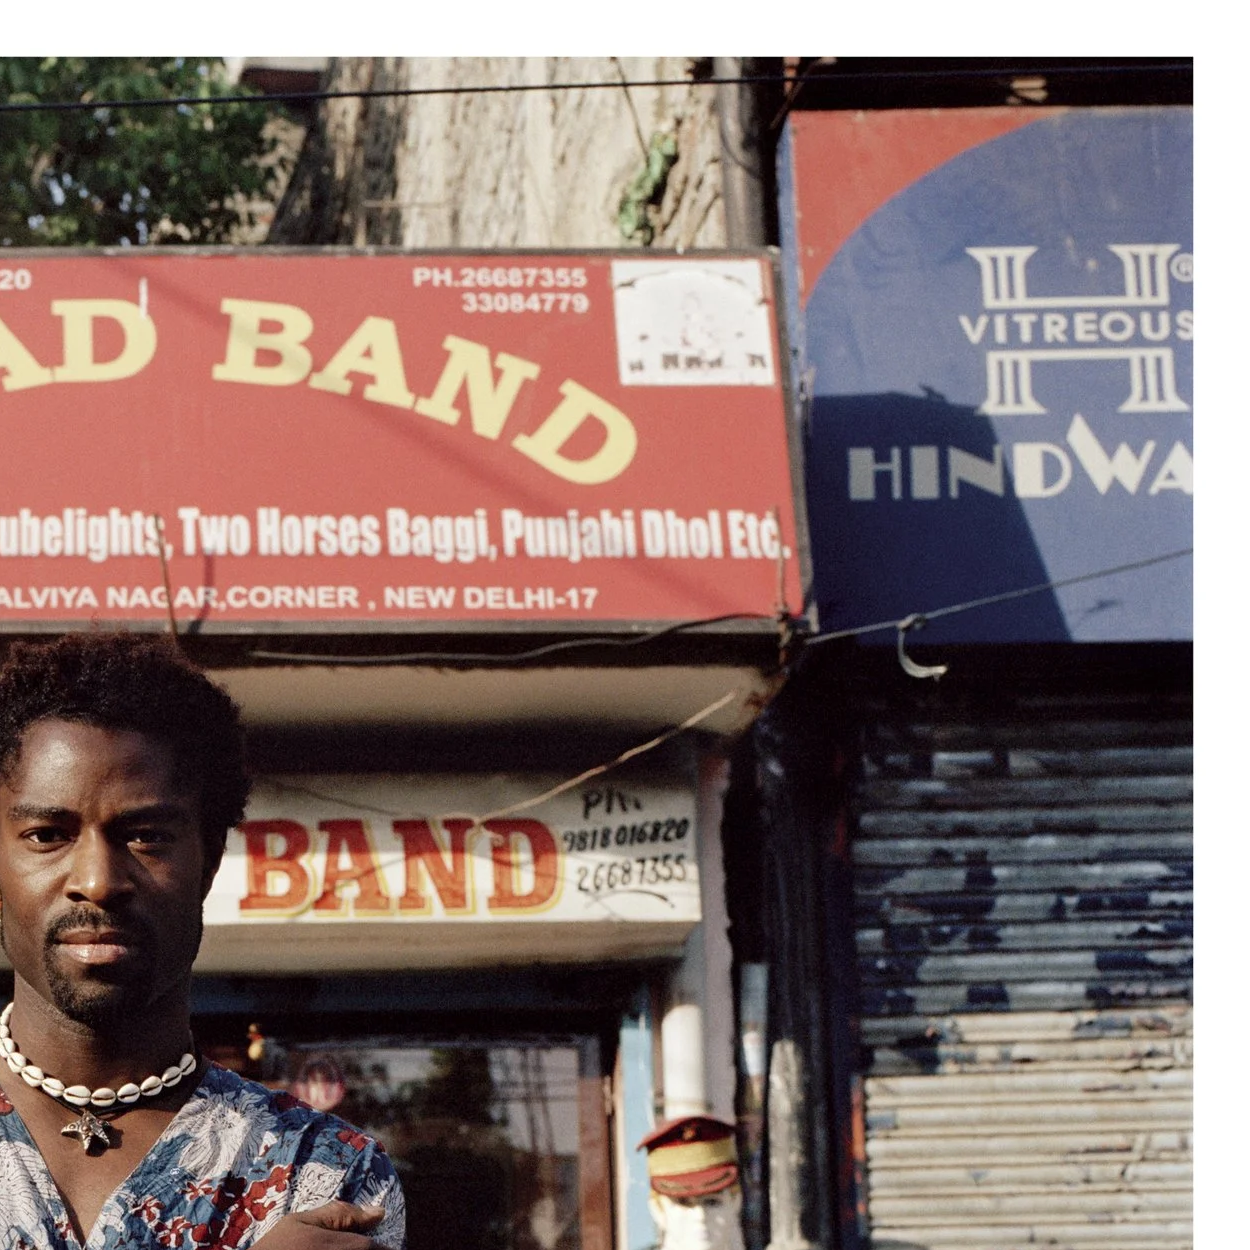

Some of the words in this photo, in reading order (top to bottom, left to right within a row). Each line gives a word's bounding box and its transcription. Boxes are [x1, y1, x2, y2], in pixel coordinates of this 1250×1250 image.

[462, 292, 589, 313] 33084779
[959, 309, 1193, 344] VITREOUS
[212, 297, 638, 485] BAND
[178, 507, 251, 557] Two
[257, 507, 381, 557] Horses
[386, 508, 498, 563] Baggi,
[501, 508, 636, 563] Punjabi
[641, 509, 724, 559] Dhol
[727, 510, 792, 560] Etc.
[384, 586, 457, 609] NEW
[464, 586, 599, 609] DELHI-17
[235, 817, 565, 917] BAND
[577, 853, 686, 892] 26687355
